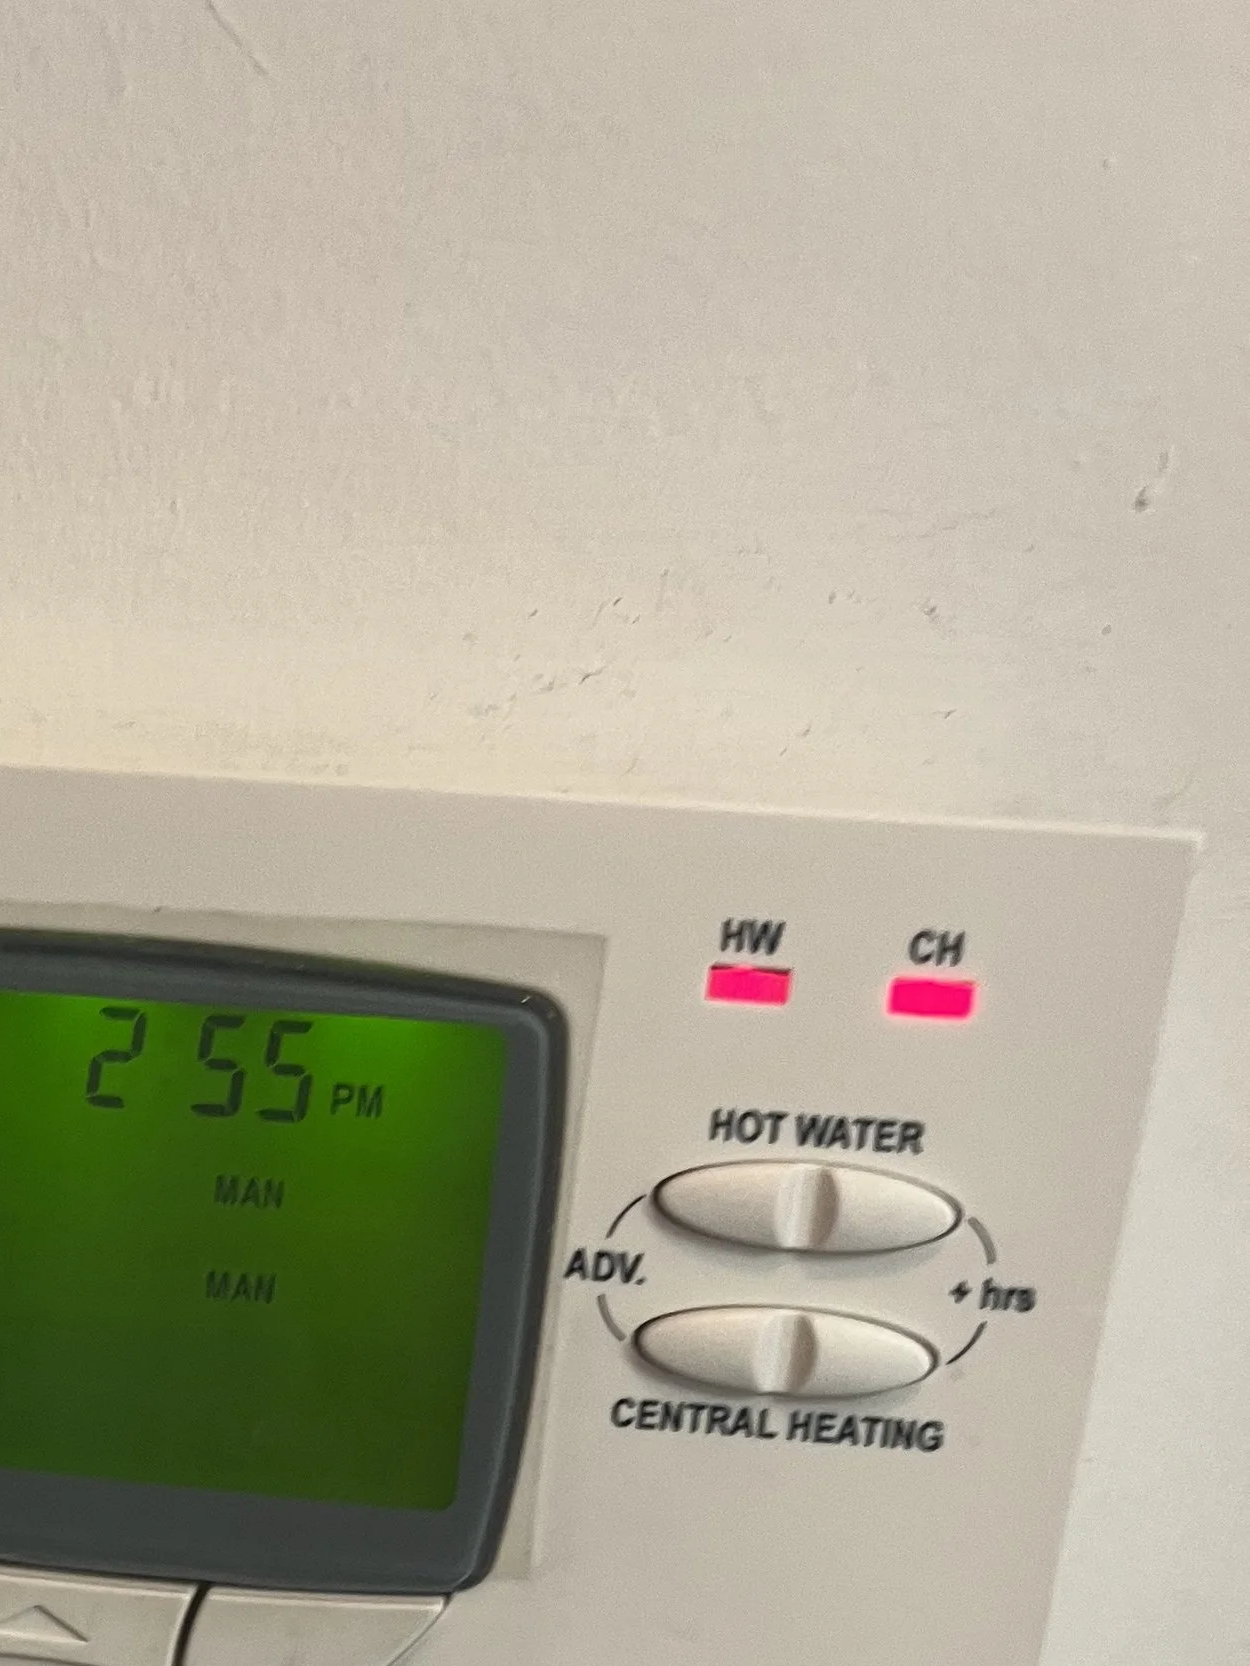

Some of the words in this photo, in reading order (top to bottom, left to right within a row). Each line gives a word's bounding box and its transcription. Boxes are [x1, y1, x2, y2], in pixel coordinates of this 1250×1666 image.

[718, 918, 787, 955] HW
[908, 928, 967, 967] CH
[86, 1006, 147, 1109] 2
[191, 1014, 314, 1123] 55
[330, 1082, 385, 1121] PM
[709, 1107, 788, 1144] HOT
[795, 1113, 926, 1155] WATER
[214, 1173, 285, 1211] MAN
[564, 1248, 646, 1286] ADV.
[205, 1270, 276, 1304] MAN
[978, 1278, 1038, 1313] hrs
[610, 1397, 777, 1441] CENTRAL
[785, 1410, 946, 1454] HEATING
